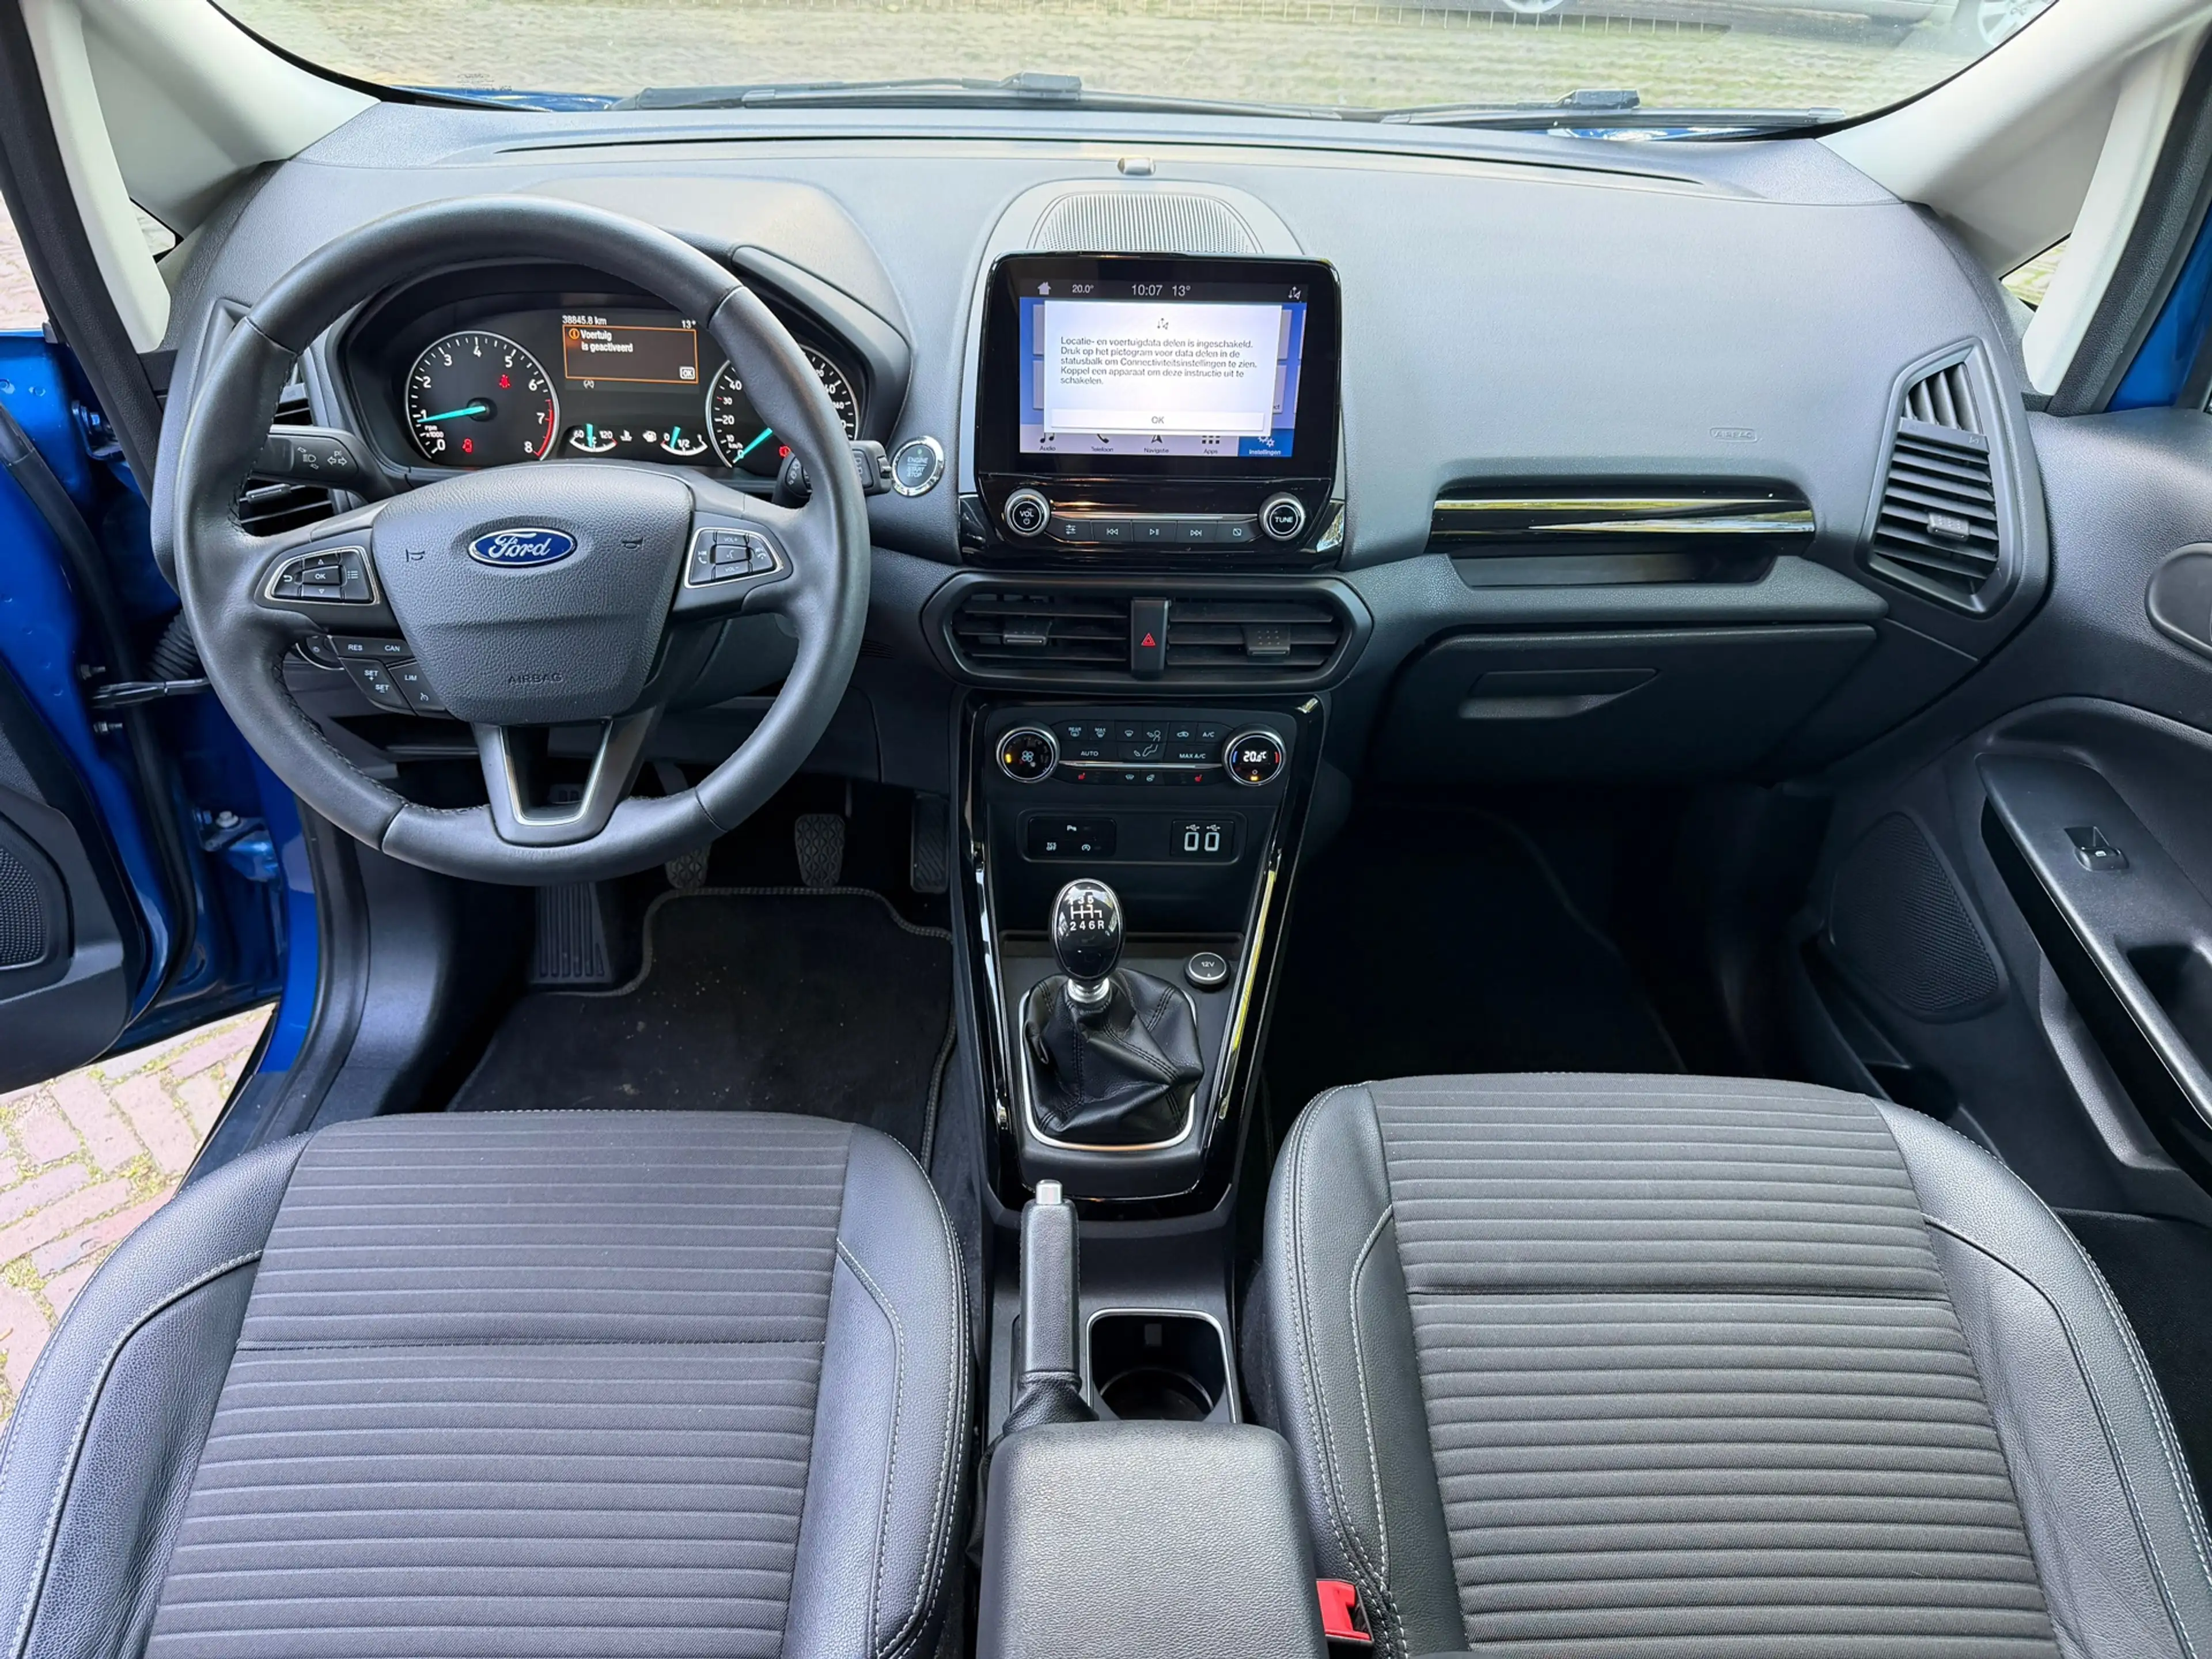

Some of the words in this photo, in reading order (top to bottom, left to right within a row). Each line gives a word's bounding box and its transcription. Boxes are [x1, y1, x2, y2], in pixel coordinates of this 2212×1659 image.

[1072, 284, 1094, 293] 20.0°
[1132, 284, 1163, 296] 10:07
[1172, 285, 1191, 297] 13°
[562, 315, 593, 324] 38845.8
[594, 316, 607, 324] km
[590, 343, 633, 353] geactiveerd
[1060, 336, 1094, 346] Locatie-
[1109, 339, 1161, 348] voertuigdata
[1163, 339, 1185, 347] delen
[1187, 339, 1195, 347] is
[1196, 339, 1253, 349] ingeschakeld.
[473, 346, 482, 358] 4
[1061, 346, 1081, 355] Druk
[1082, 348, 1094, 356] op
[1096, 347, 1108, 355] het
[1110, 348, 1153, 357] pictogram
[1175, 349, 1193, 357] data
[1220, 349, 1228, 357] in
[1229, 350, 1240, 358] de
[444, 354, 452, 366] 3
[504, 356, 513, 368] 5
[1120, 357, 1226, 369] Connectiviteitsinstellingen
[1228, 360, 1237, 368] te
[1238, 359, 1257, 368] zien.
[1060, 366, 1090, 376] Koppel
[1109, 368, 1145, 377] apparaat
[1162, 369, 1183, 377] deze
[1184, 369, 1222, 377] instructie
[1236, 370, 1244, 378] te
[422, 376, 431, 388] 2
[528, 379, 537, 391] 6
[729, 380, 742, 390] 40
[1060, 376, 1104, 385] schakelen.
[722, 396, 732, 405] 30
[536, 412, 545, 424] 7
[722, 415, 734, 425] 20
[1151, 416, 1164, 425] OK
[573, 430, 584, 438] 60
[599, 431, 613, 439] 120
[437, 439, 445, 450] 0
[524, 441, 533, 453] 8
[488, 532, 551, 559] Ford
[507, 672, 563, 684] AIRBAG
[1078, 896, 1085, 904] 3
[1088, 895, 1094, 904] 5
[1070, 921, 1077, 931] 2
[1079, 921, 1086, 930] 4
[1089, 921, 1095, 930] 6
[1097, 920, 1104, 930] R
